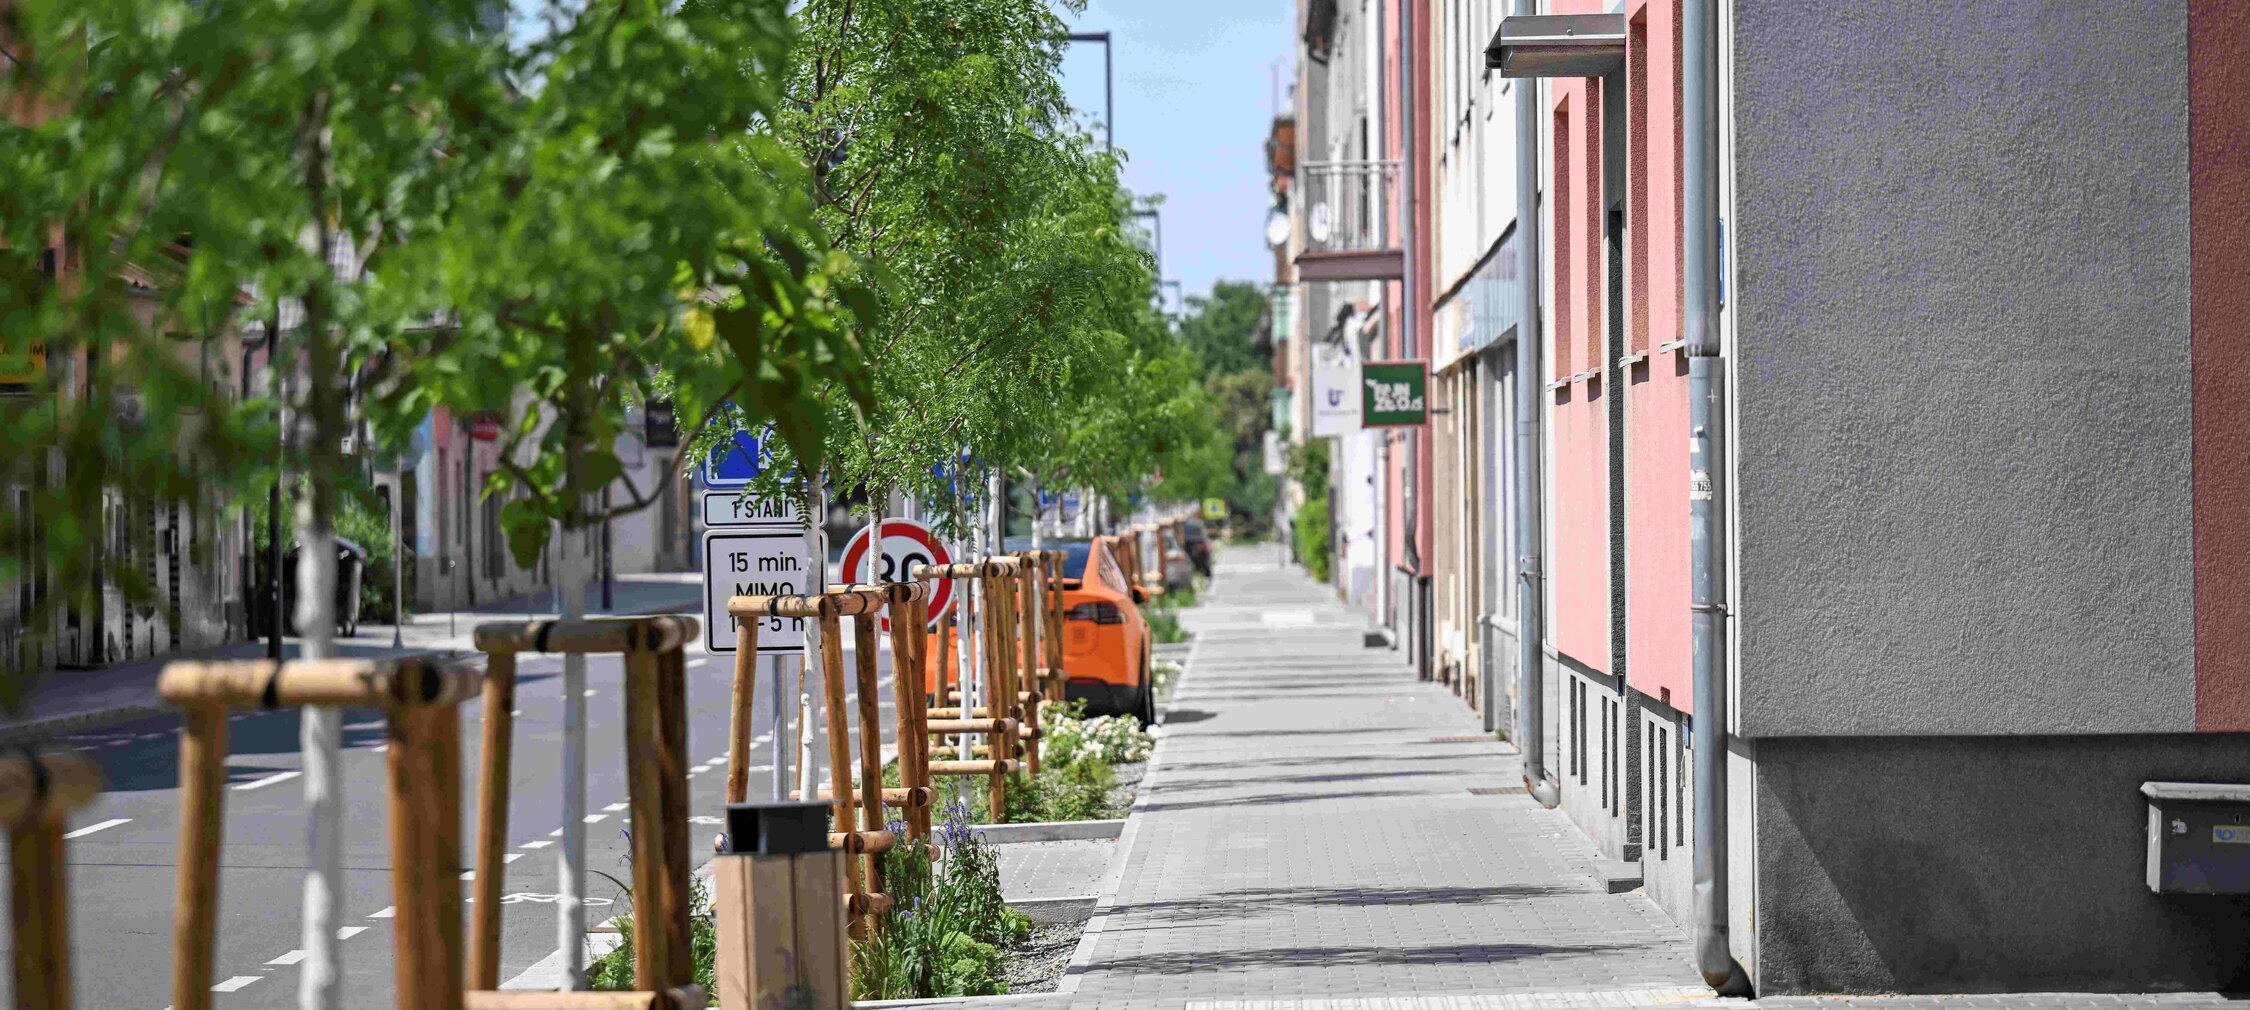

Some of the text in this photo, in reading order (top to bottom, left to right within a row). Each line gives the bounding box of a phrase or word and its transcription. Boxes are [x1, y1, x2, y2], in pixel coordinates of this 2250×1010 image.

[731, 501, 738, 518] 1
[728, 551, 802, 572] 15 min.
[736, 582, 794, 596] MIMO
